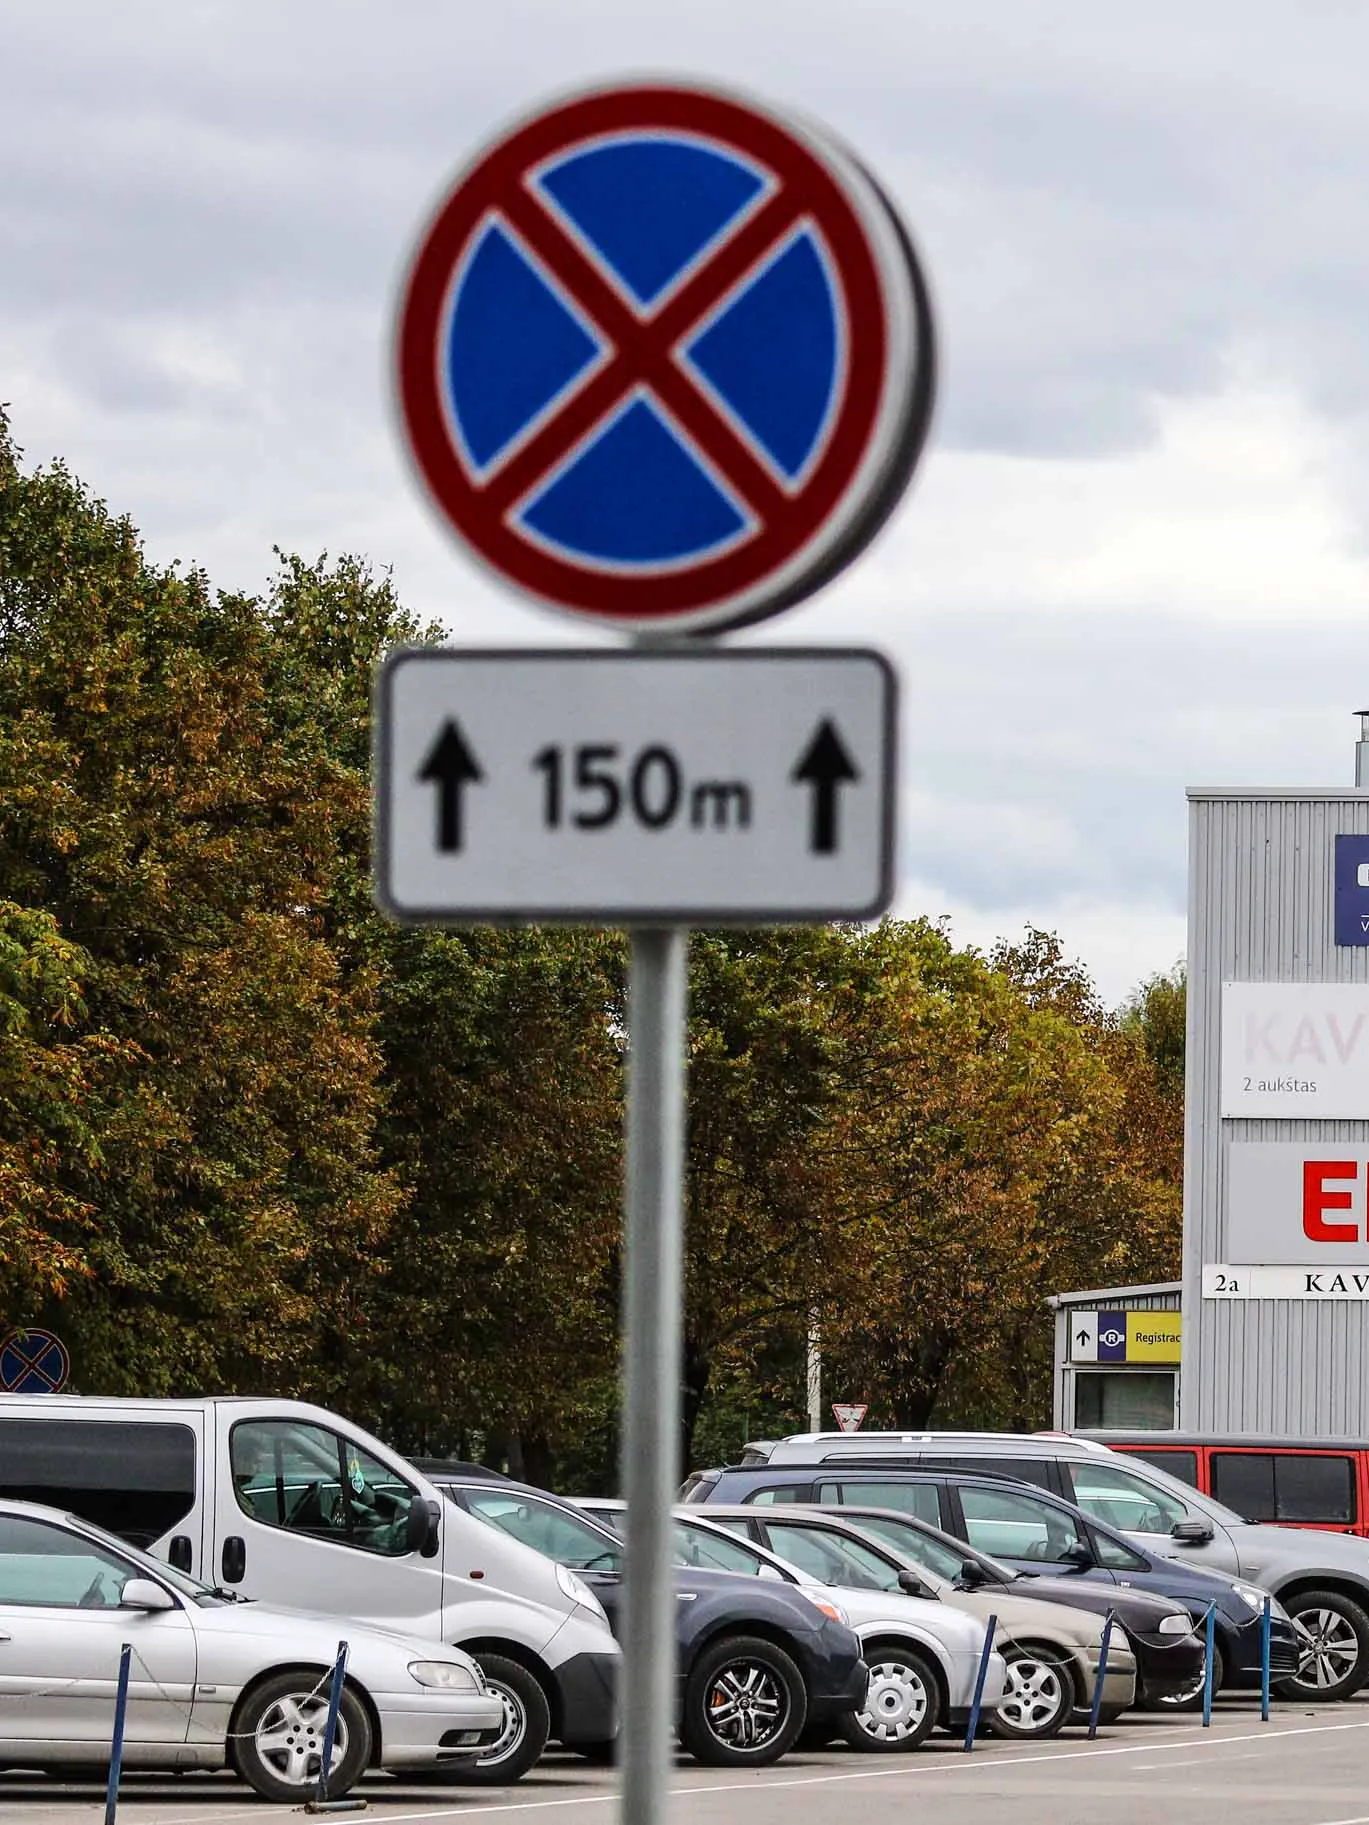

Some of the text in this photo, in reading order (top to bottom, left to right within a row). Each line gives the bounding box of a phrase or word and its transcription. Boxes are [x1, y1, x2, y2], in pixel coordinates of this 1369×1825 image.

[532, 744, 751, 830] 150m
[1243, 1077, 1252, 1092] 2
[1214, 1274, 1240, 1292] 2a
